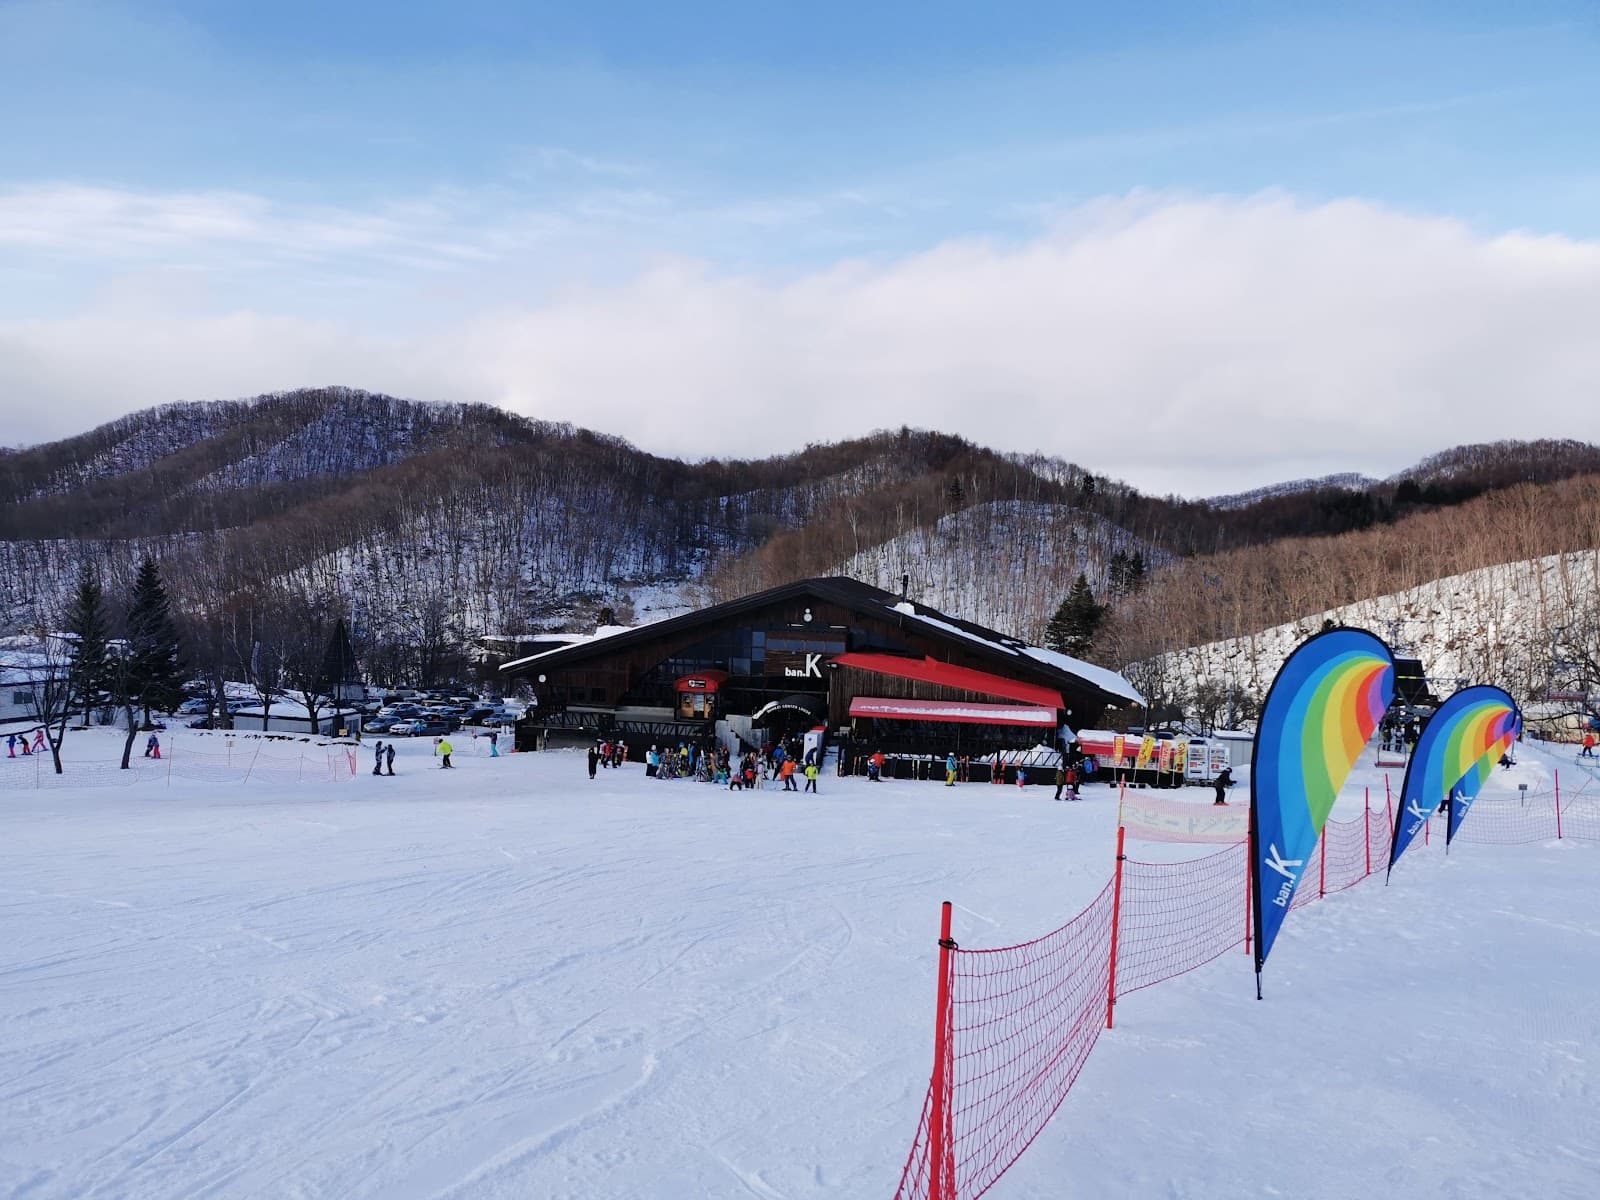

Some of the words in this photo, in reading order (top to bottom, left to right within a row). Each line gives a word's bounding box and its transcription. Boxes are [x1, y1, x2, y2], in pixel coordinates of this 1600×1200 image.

[784, 653, 822, 678] ban.K
[1406, 797, 1431, 836] ban.K
[1264, 842, 1303, 908] ban.K
